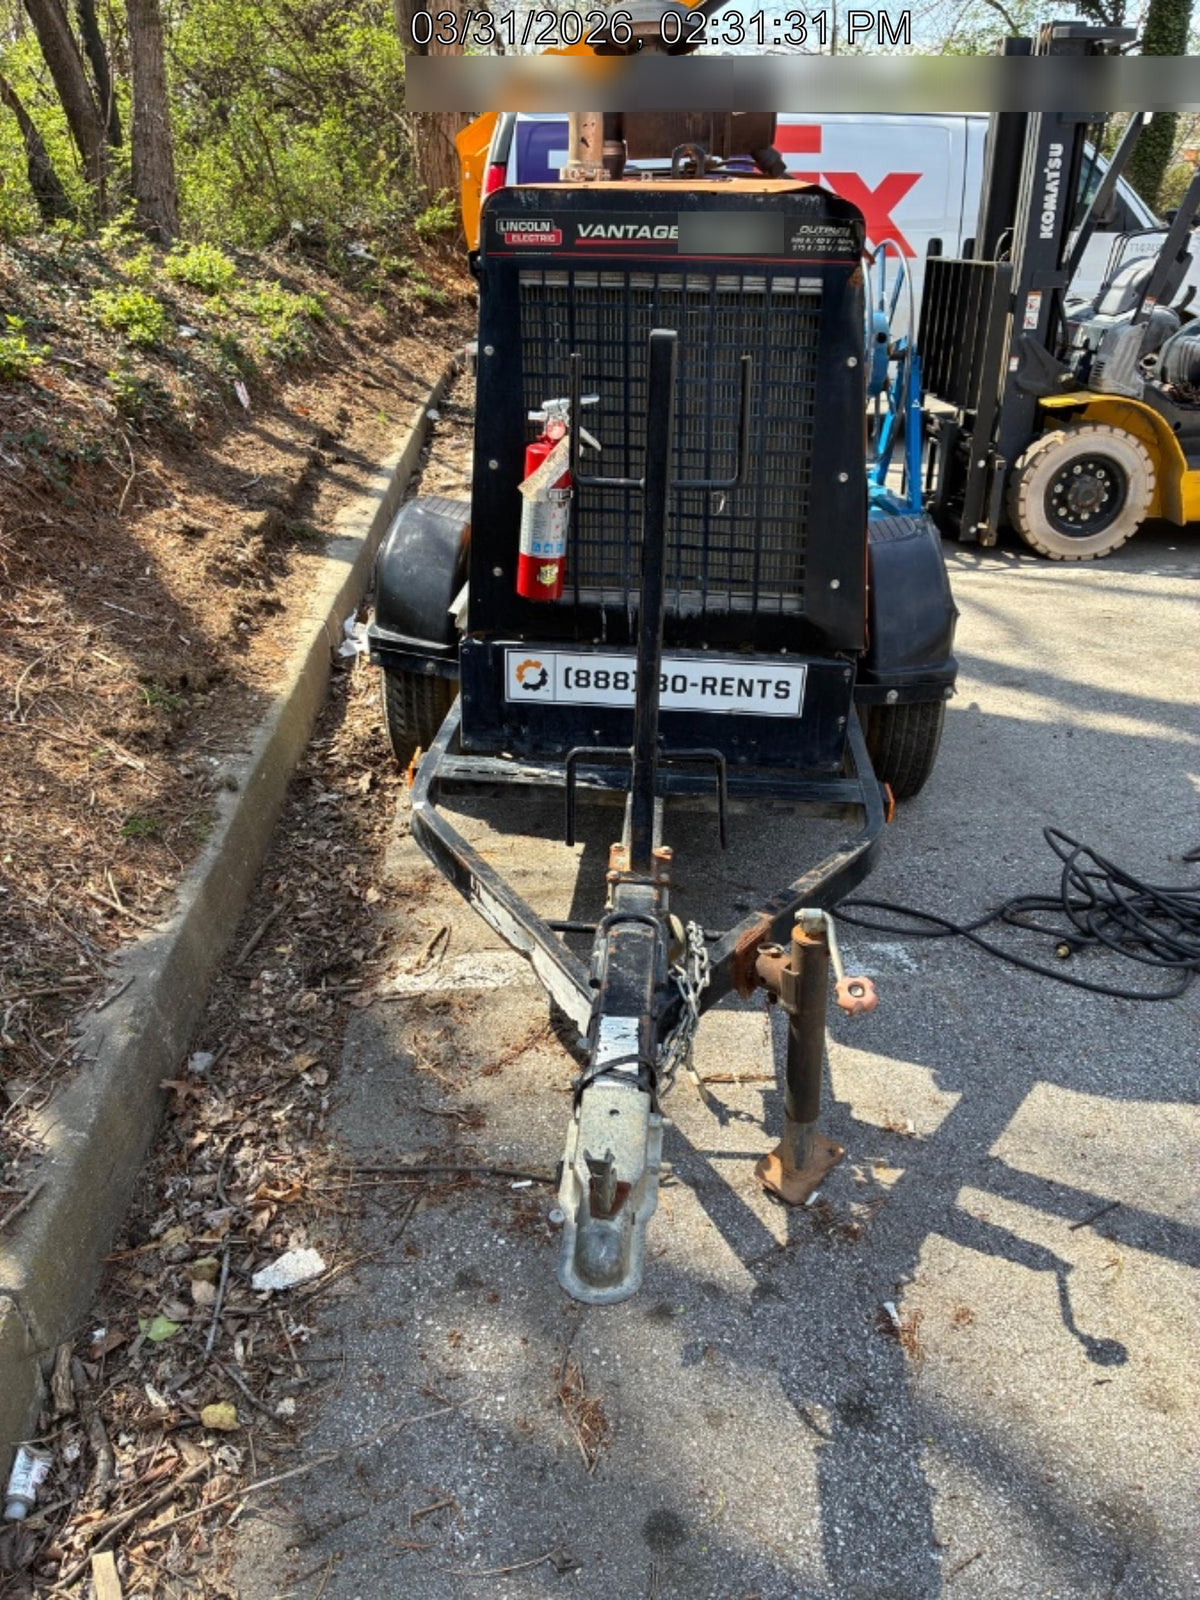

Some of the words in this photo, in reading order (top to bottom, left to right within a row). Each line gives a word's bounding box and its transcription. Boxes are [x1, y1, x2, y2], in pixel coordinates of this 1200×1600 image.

[1040, 143, 1064, 239] KOMATSU
[500, 221, 551, 232] LINCOLN
[577, 223, 678, 239] VANTAGE
[511, 233, 556, 243] ELECTRIC
[564, 667, 638, 692] (888)
